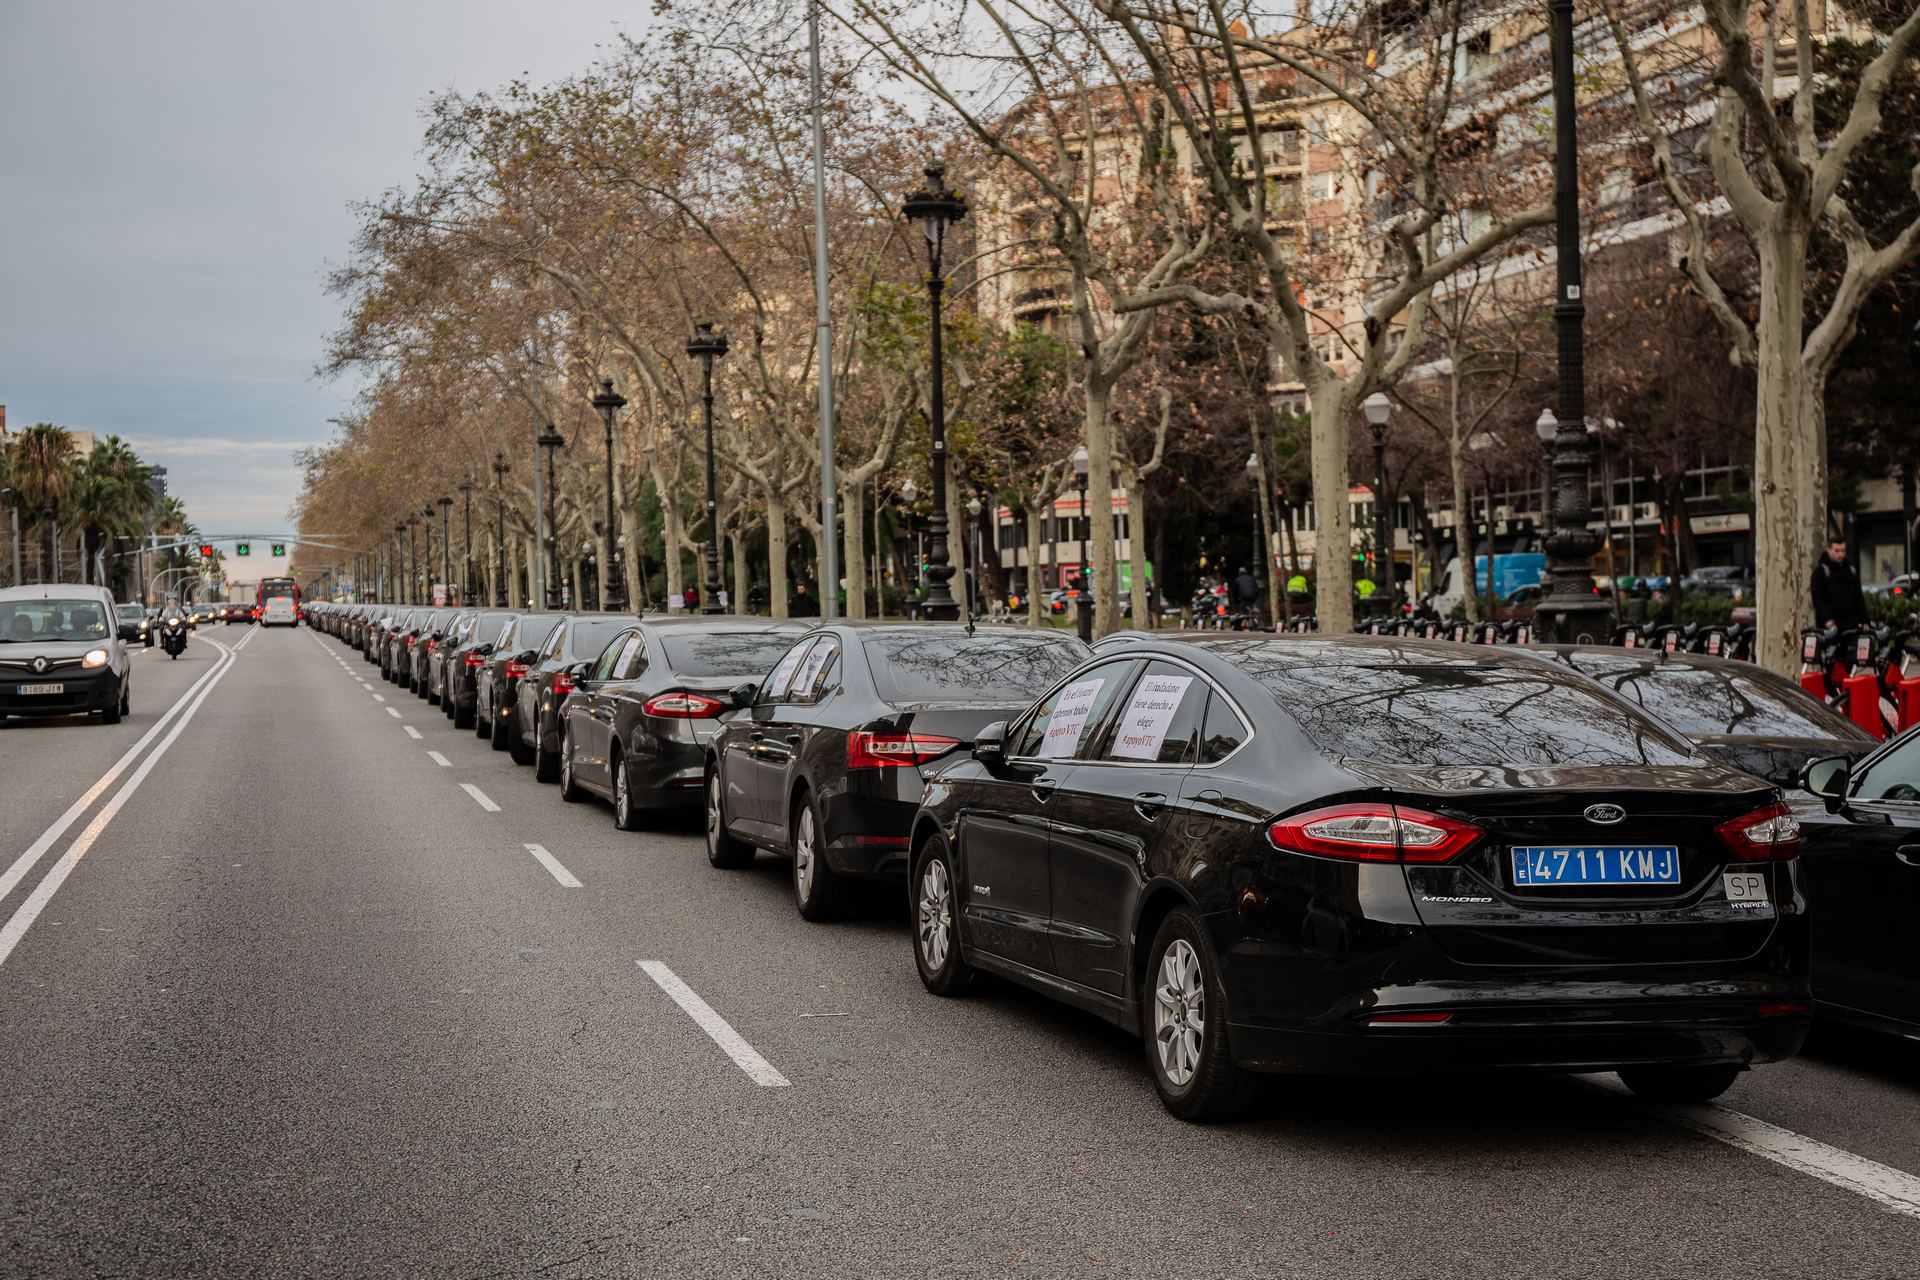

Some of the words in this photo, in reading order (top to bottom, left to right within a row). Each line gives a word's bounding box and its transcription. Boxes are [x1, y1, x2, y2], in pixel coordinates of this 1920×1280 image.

[1073, 704, 1089, 716] todos
[1134, 699, 1147, 708] tiene
[1147, 699, 1168, 710] derecho
[1137, 716, 1154, 730] elegir
[1593, 807, 1618, 820] Ford
[1535, 850, 1606, 880] 4711
[1619, 850, 1673, 880] KMJ
[1518, 869, 1526, 879] E
[1731, 877, 1760, 896] SP
[1731, 901, 1765, 909] HYBRID
